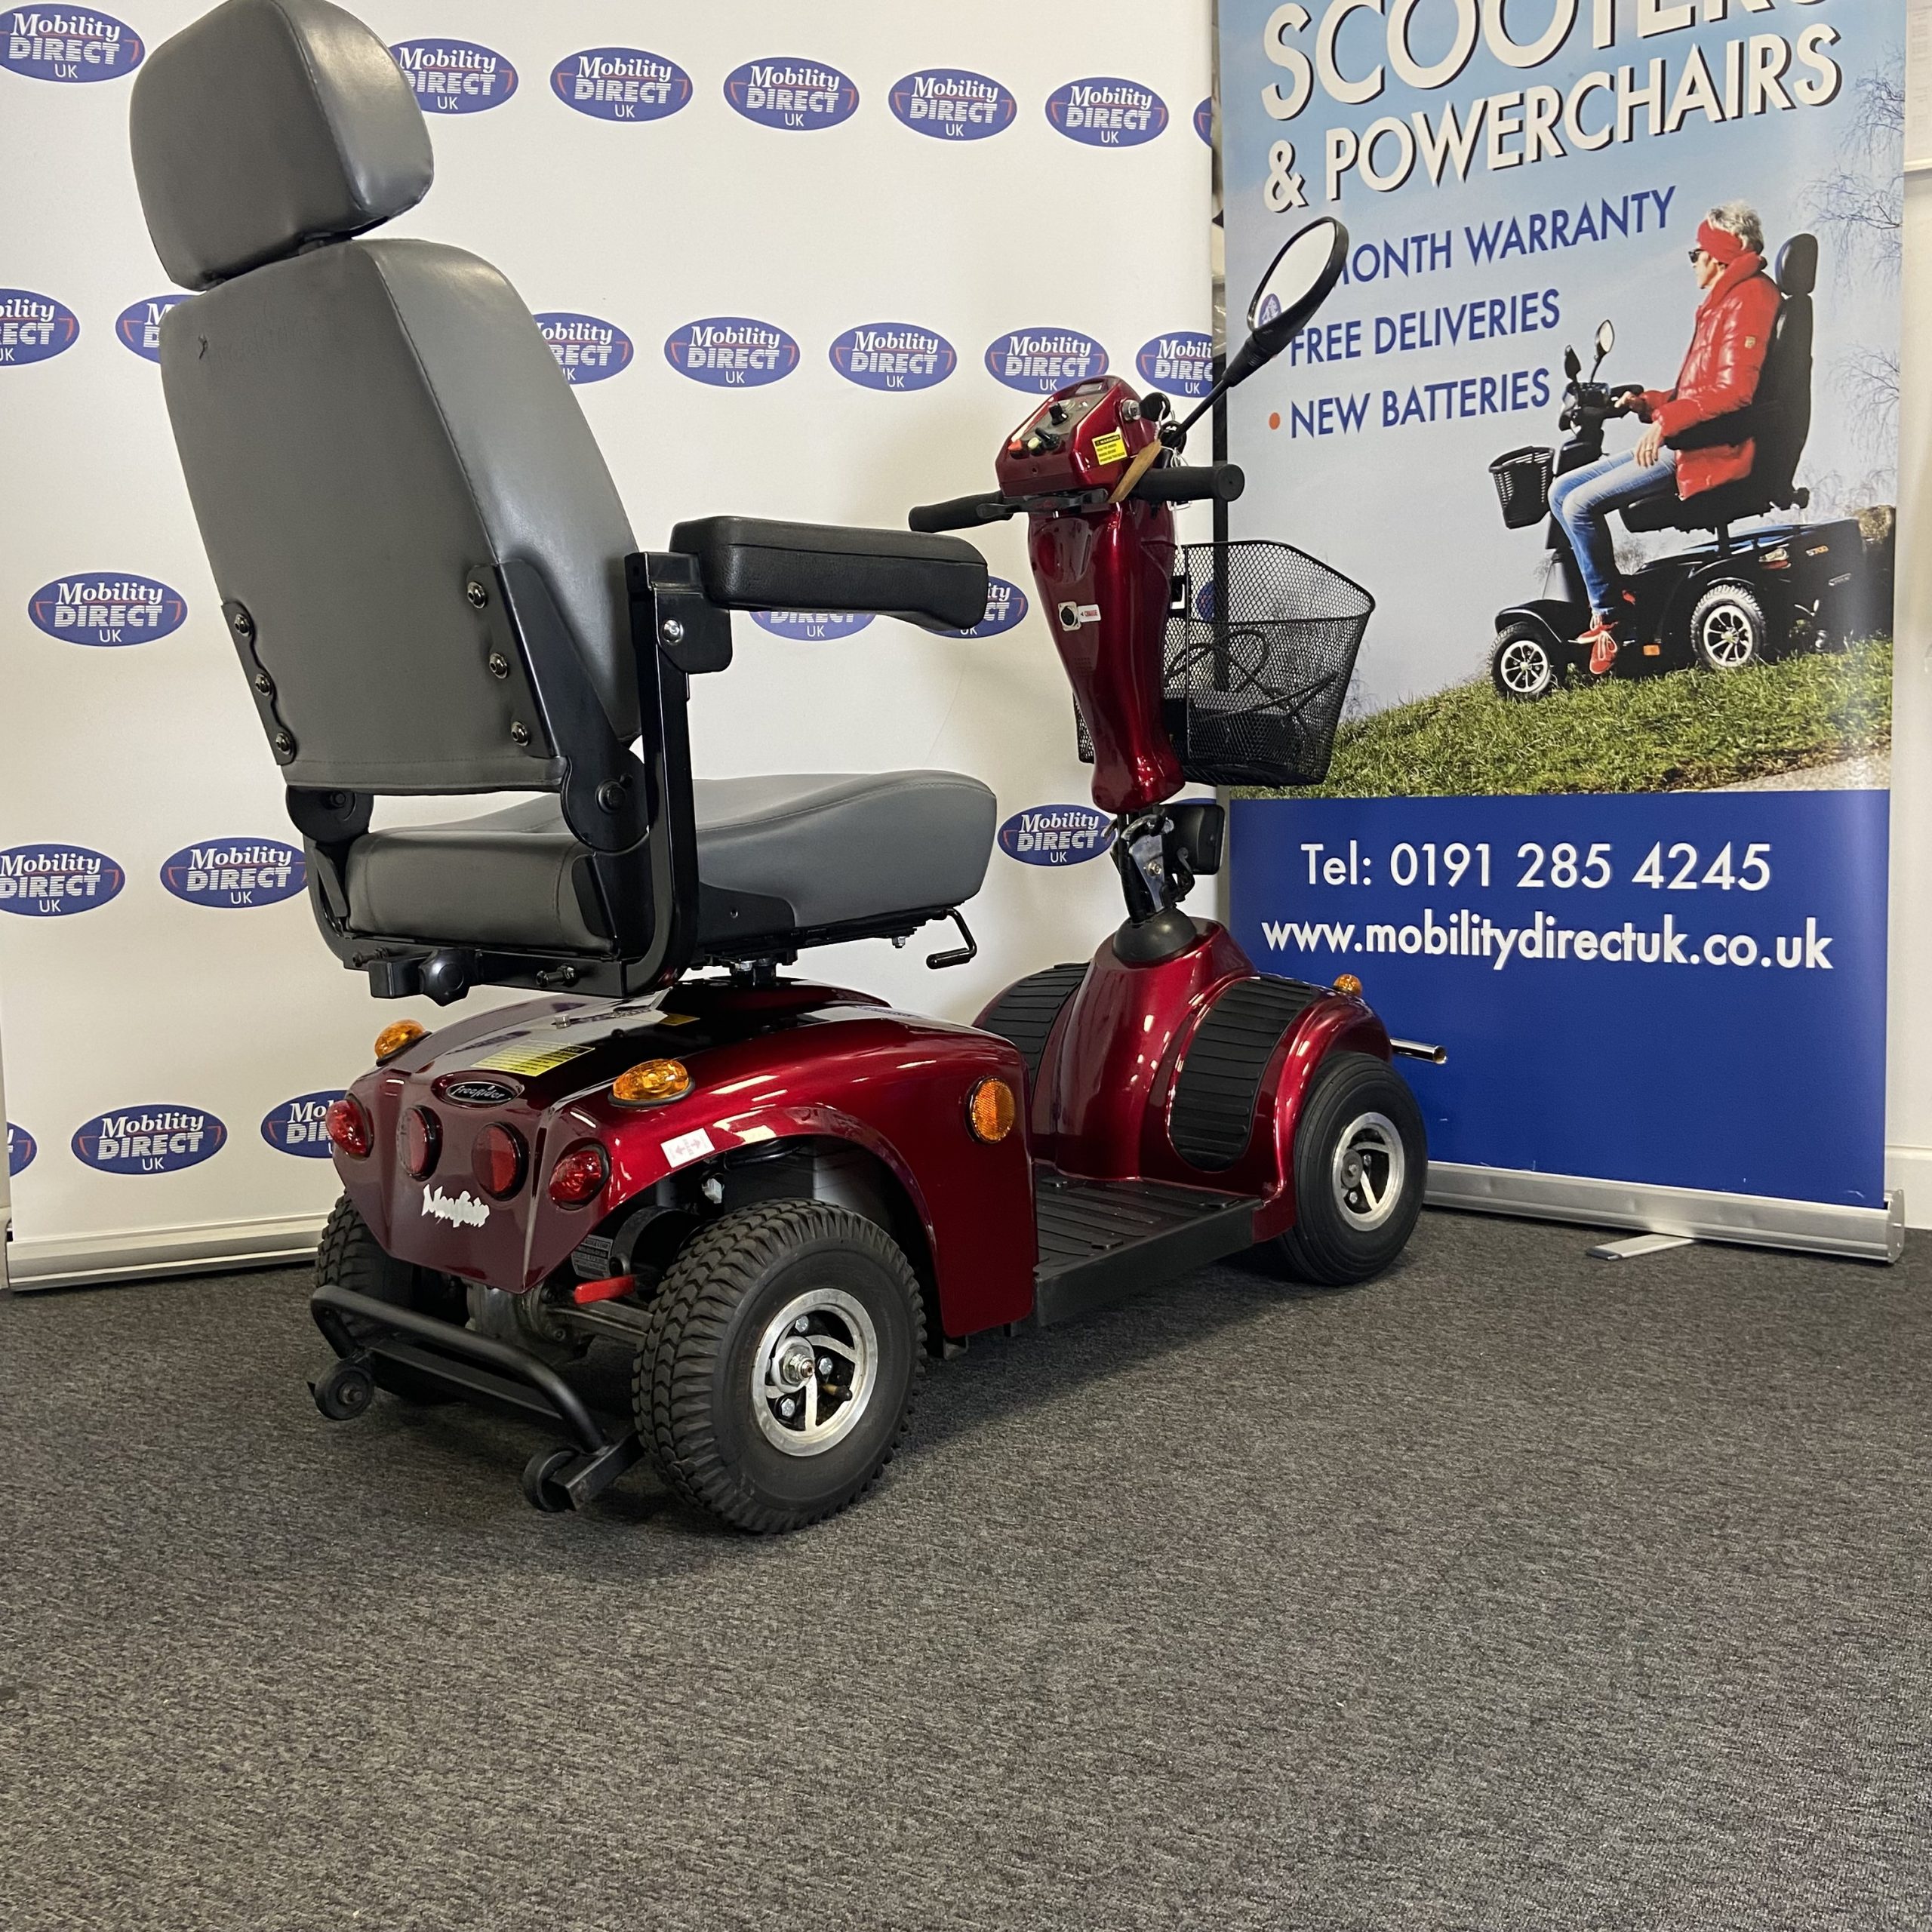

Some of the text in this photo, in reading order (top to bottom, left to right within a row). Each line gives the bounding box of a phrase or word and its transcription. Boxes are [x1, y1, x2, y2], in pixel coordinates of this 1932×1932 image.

[10, 13, 120, 42] Mobility
[9, 37, 120, 65] DIRECT
[399, 48, 496, 73] Mobility
[1261, 0, 1823, 121] SCOO
[54, 64, 78, 78] UK
[576, 56, 672, 82] Mobility
[748, 66, 840, 91] Mobility
[574, 78, 672, 103] DIRECT
[746, 88, 839, 113] DIRECT
[911, 76, 998, 103] Mobility
[1067, 85, 1152, 110] Mobility
[437, 96, 458, 110] UK
[615, 104, 635, 118] UK
[909, 98, 998, 123] DIRECT
[785, 113, 804, 127] UK
[1066, 106, 1151, 131] DIRECT
[1263, 23, 1841, 213] & POWERCHAIRS
[946, 124, 964, 137] UK
[1101, 131, 1119, 143] UK
[1341, 186, 1676, 285] ONTH WARRANTY
[537, 322, 613, 345] obility
[689, 326, 780, 349] Mobility
[1291, 288, 1560, 367] FREE DELIVERIES
[852, 331, 938, 354] Mobility
[1007, 336, 1091, 357] Mobility
[1156, 340, 1212, 359] Mobili
[549, 344, 613, 366] RECT
[687, 347, 780, 370] DIRECT
[851, 352, 937, 374] DIRECT
[1005, 356, 1091, 377] DIRECT
[725, 371, 745, 384] UK
[886, 375, 905, 388] UK
[1155, 359, 1213, 382] DIREC
[1040, 379, 1057, 391] UK
[1185, 382, 1200, 394] UK
[1291, 368, 1550, 438] NEW BATTERIES
[55, 582, 163, 605] Mobility
[54, 605, 163, 627] DIRECT
[99, 629, 122, 642] UK
[807, 625, 825, 637] UK
[1019, 812, 1100, 832] Mobility
[1017, 831, 1099, 851] DIRECT
[0, 854, 101, 876] Mobility
[188, 846, 292, 869] Mobility
[1051, 851, 1067, 863] UK
[1300, 840, 1770, 891] Tel: 0191 285 4245
[0, 875, 100, 898] DIRECT
[186, 866, 292, 891] DIRECT
[39, 899, 61, 912] UK
[230, 891, 252, 904] UK
[1261, 909, 1834, 971] www.mobilitydirectuk.co.uk
[99, 1112, 204, 1139] Mobility
[97, 1131, 204, 1160] DIRECT
[142, 1157, 165, 1171] UK
